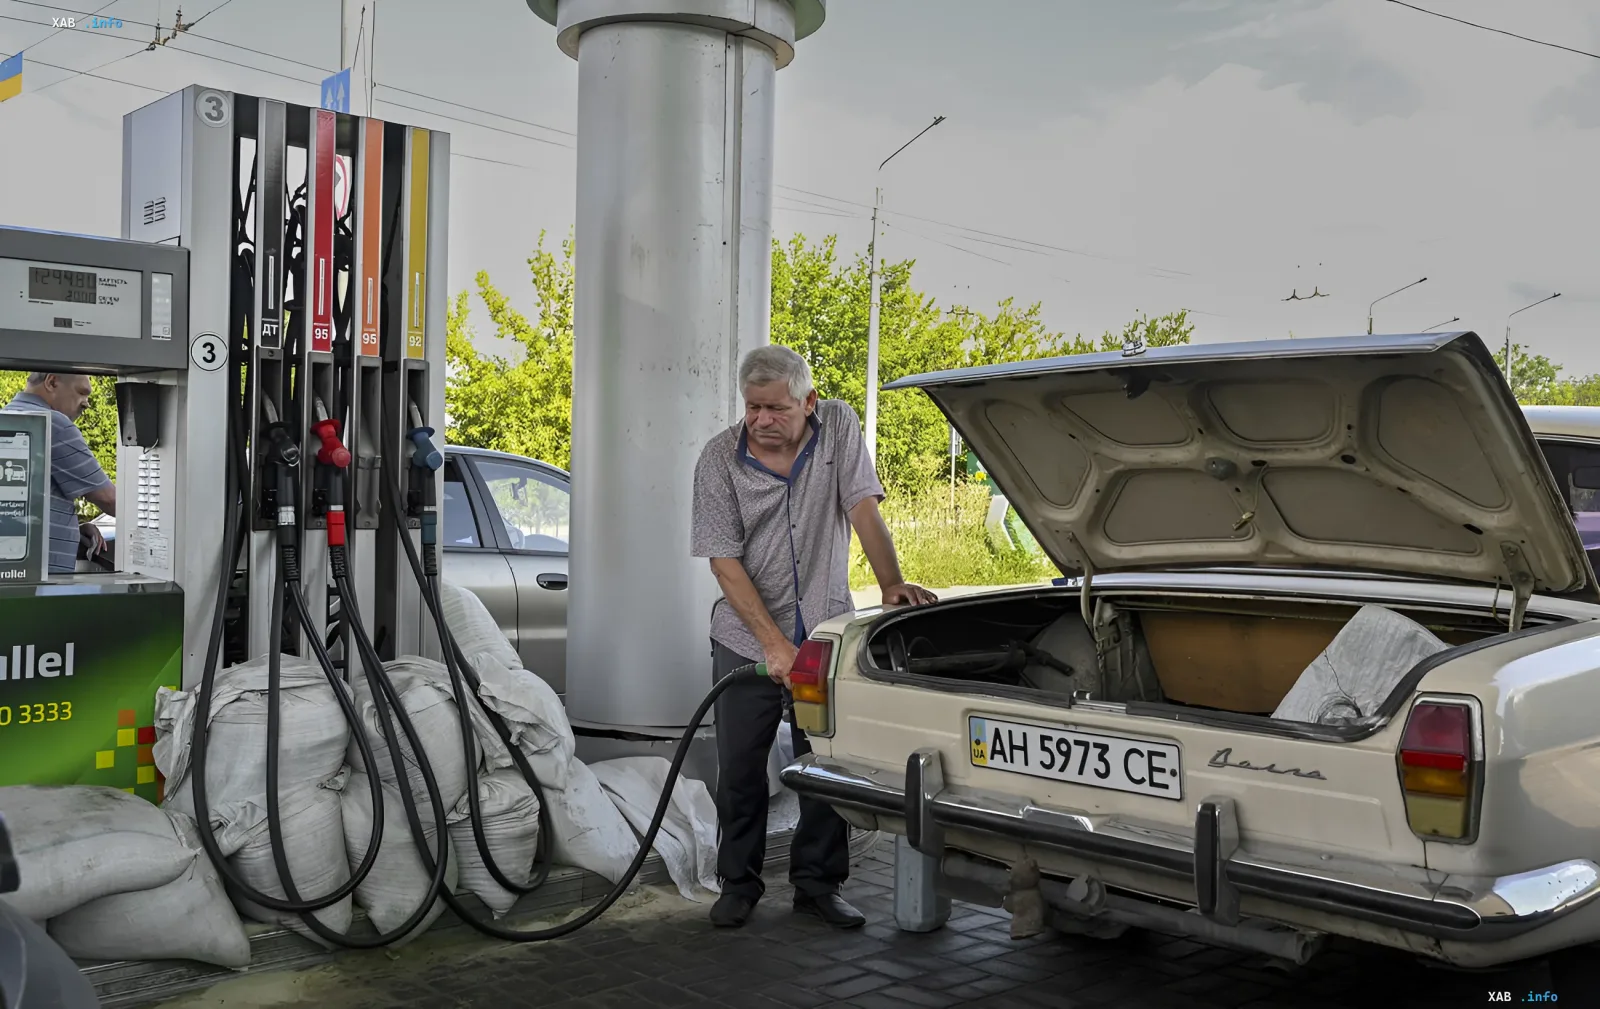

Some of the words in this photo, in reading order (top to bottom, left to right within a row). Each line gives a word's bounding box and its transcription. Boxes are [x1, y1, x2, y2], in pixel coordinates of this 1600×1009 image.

[204, 96, 225, 122] 3
[262, 323, 279, 336] ДТ
[314, 328, 329, 340] 95
[362, 332, 377, 344] 95
[409, 335, 422, 347] 92
[202, 342, 216, 364] 3
[18, 701, 72, 724] 3333
[973, 748, 985, 759] UA
[990, 727, 1028, 766] AH
[1040, 735, 1111, 780] 5973
[1123, 747, 1169, 790] CE
